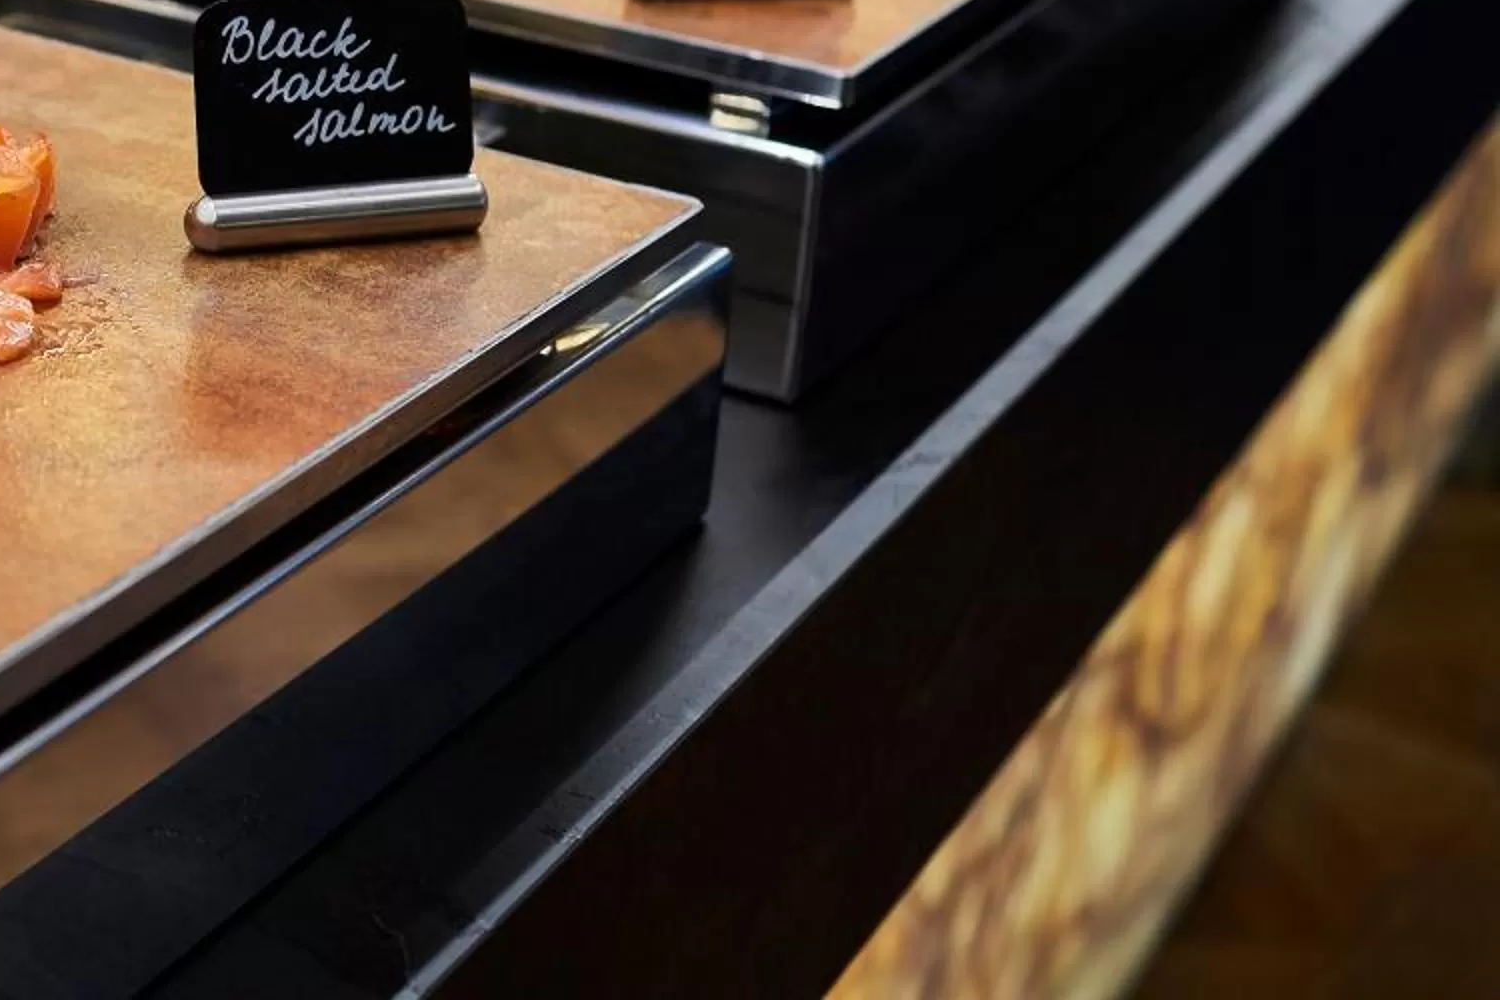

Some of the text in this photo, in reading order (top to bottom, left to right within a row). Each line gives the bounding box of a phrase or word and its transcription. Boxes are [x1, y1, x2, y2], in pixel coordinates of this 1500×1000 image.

[221, 15, 371, 64] Black
[252, 53, 405, 103] salted
[293, 102, 456, 146] salmon
